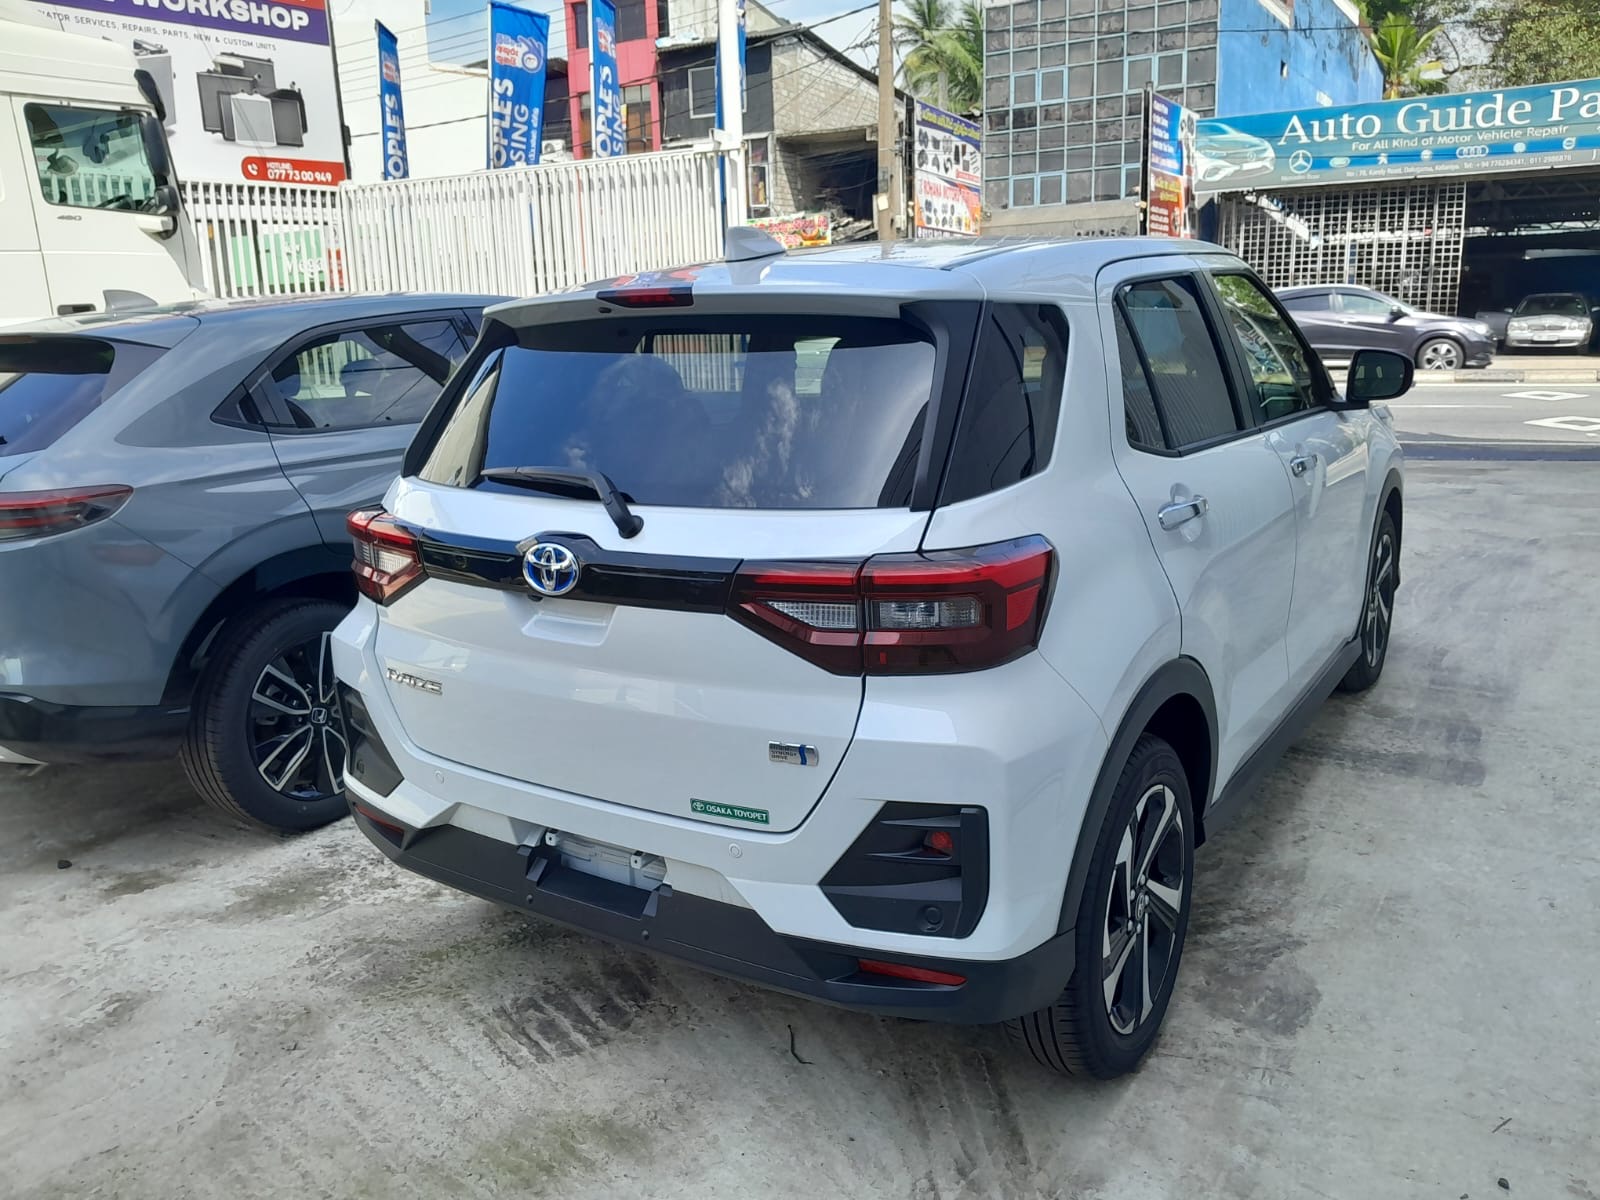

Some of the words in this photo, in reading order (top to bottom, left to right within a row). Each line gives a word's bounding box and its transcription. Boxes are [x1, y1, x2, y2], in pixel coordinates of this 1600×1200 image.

[38, 10, 70, 22] ATOR
[75, 16, 120, 30] SERVICES,
[193, 33, 211, 43] NEW
[223, 38, 254, 48] CUSTOM
[256, 42, 276, 52] UNITS
[1276, 113, 1381, 146] Auto
[1396, 93, 1532, 134] Guide
[1351, 141, 1370, 151] For
[1373, 140, 1389, 150] All
[1392, 137, 1418, 148] Kind
[1421, 136, 1434, 146] of
[1437, 133, 1473, 145] Motor
[1476, 129, 1523, 143] Vehicle
[1527, 124, 1568, 138] Repair
[705, 804, 733, 817] OSAKA
[734, 808, 767, 821] TOYOPET
